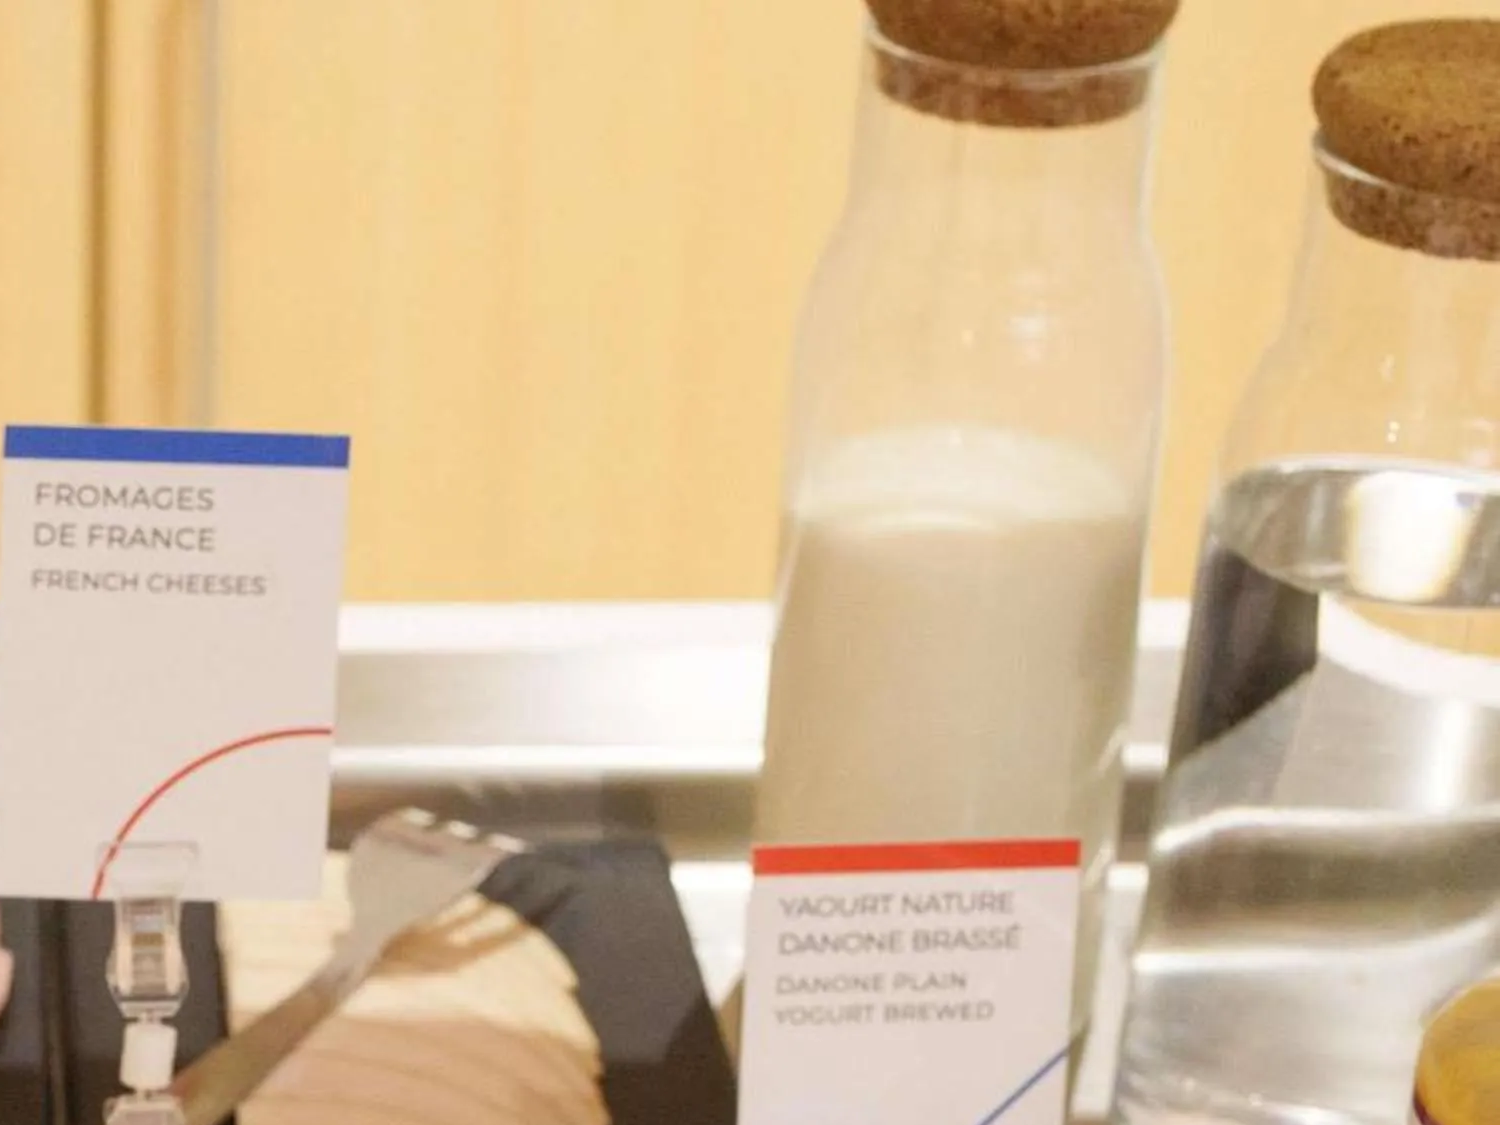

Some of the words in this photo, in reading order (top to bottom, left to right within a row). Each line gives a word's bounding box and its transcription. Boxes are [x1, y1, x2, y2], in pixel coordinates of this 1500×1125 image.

[34, 482, 216, 512] FROMAGES
[32, 522, 77, 547] DE
[87, 525, 217, 552] FRANCE
[31, 569, 138, 592] FRENCH
[146, 572, 267, 596] CHEESES
[777, 893, 895, 918] YAOURT
[901, 890, 1015, 916] NATURE
[777, 931, 904, 955] DANONE
[911, 923, 1023, 953] BRASSÉ
[775, 973, 885, 995] DANONE
[892, 971, 967, 992] PLAIN
[773, 1004, 875, 1026] YOGURT
[882, 1000, 995, 1023] BREWED
